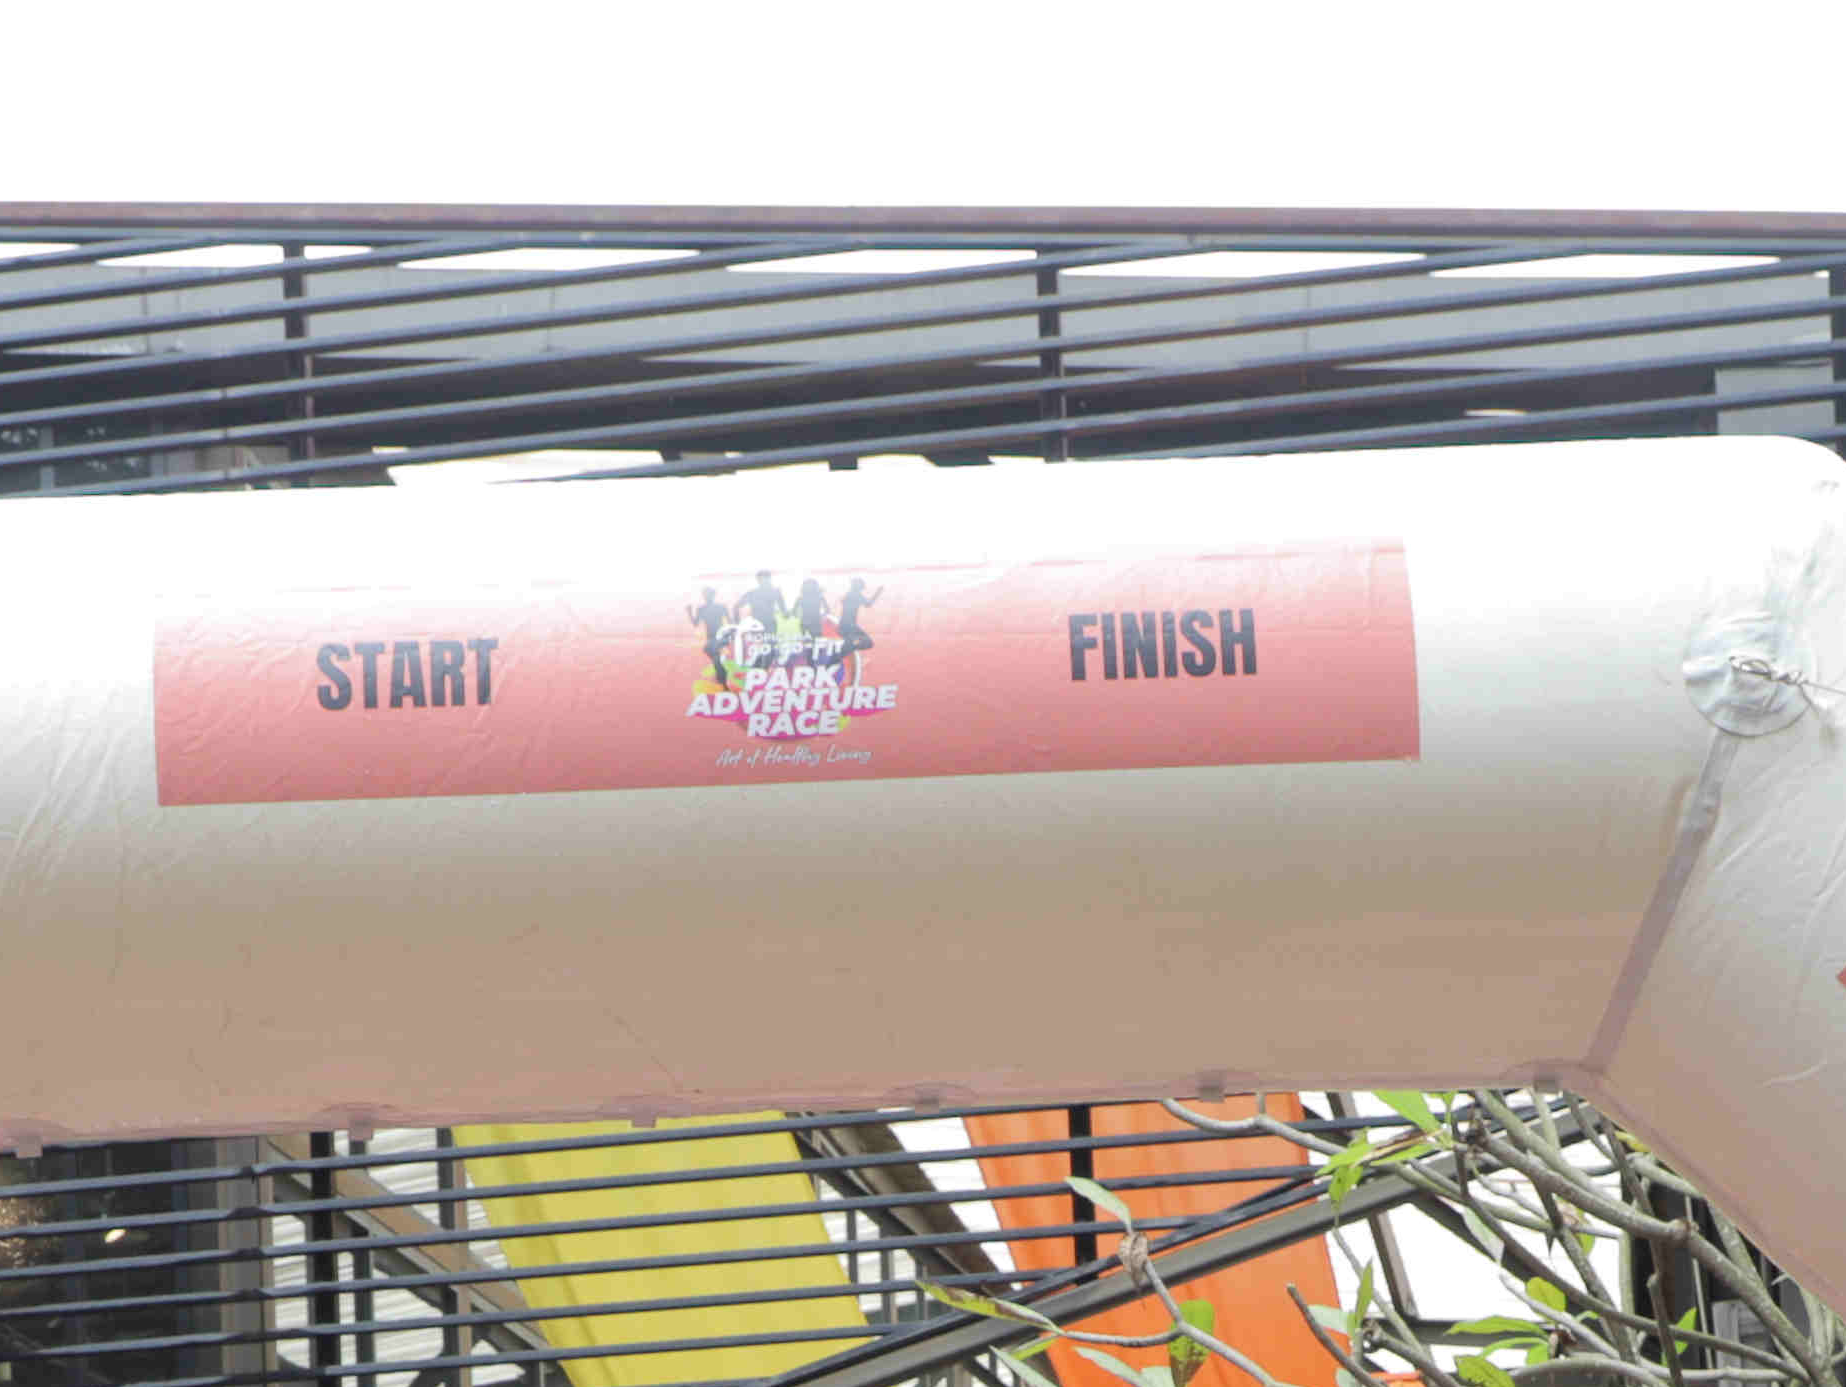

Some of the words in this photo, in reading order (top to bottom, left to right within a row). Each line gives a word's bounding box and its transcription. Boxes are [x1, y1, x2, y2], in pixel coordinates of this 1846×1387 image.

[1069, 608, 1257, 681] FINISH
[316, 637, 498, 710] START
[744, 664, 845, 692] PARK
[686, 684, 899, 717] ADVENTURE
[747, 710, 842, 738] RACE
